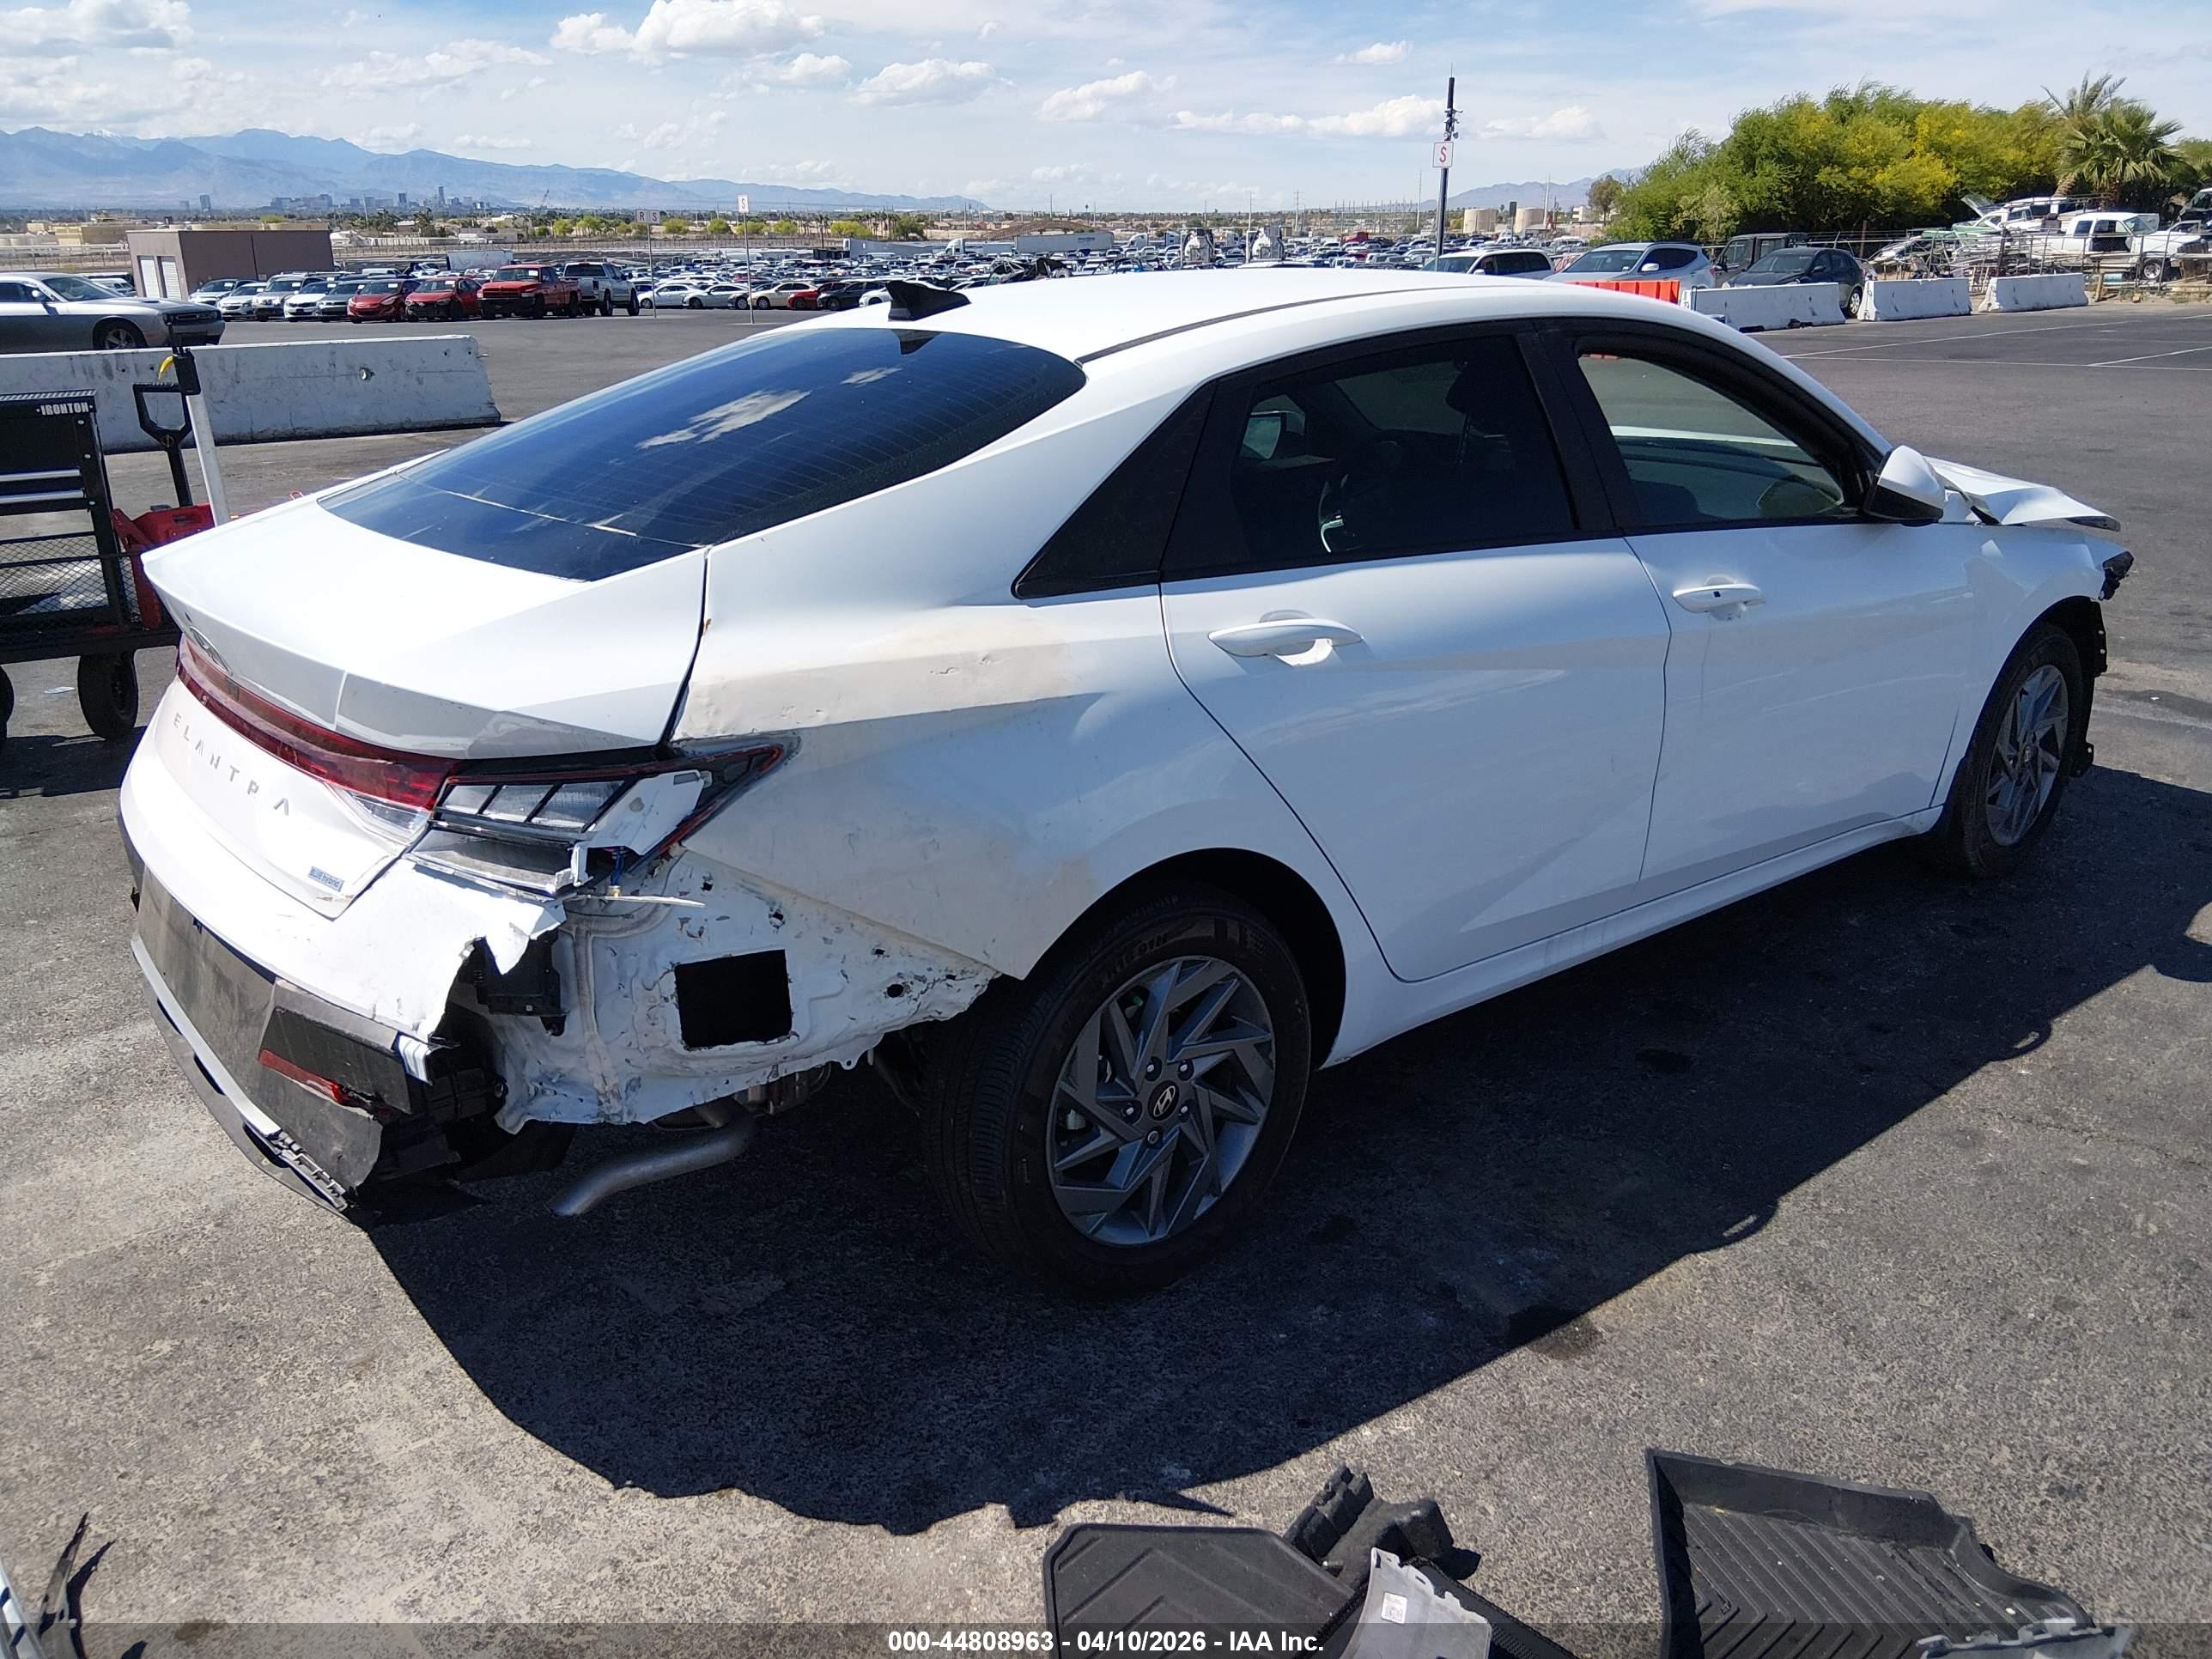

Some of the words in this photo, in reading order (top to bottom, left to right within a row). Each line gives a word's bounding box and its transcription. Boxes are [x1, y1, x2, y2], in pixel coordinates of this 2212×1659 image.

[639, 211, 646, 222] R
[652, 212, 658, 222] S
[40, 402, 89, 416] IRONTON
[173, 712, 289, 817] ELANTRA
